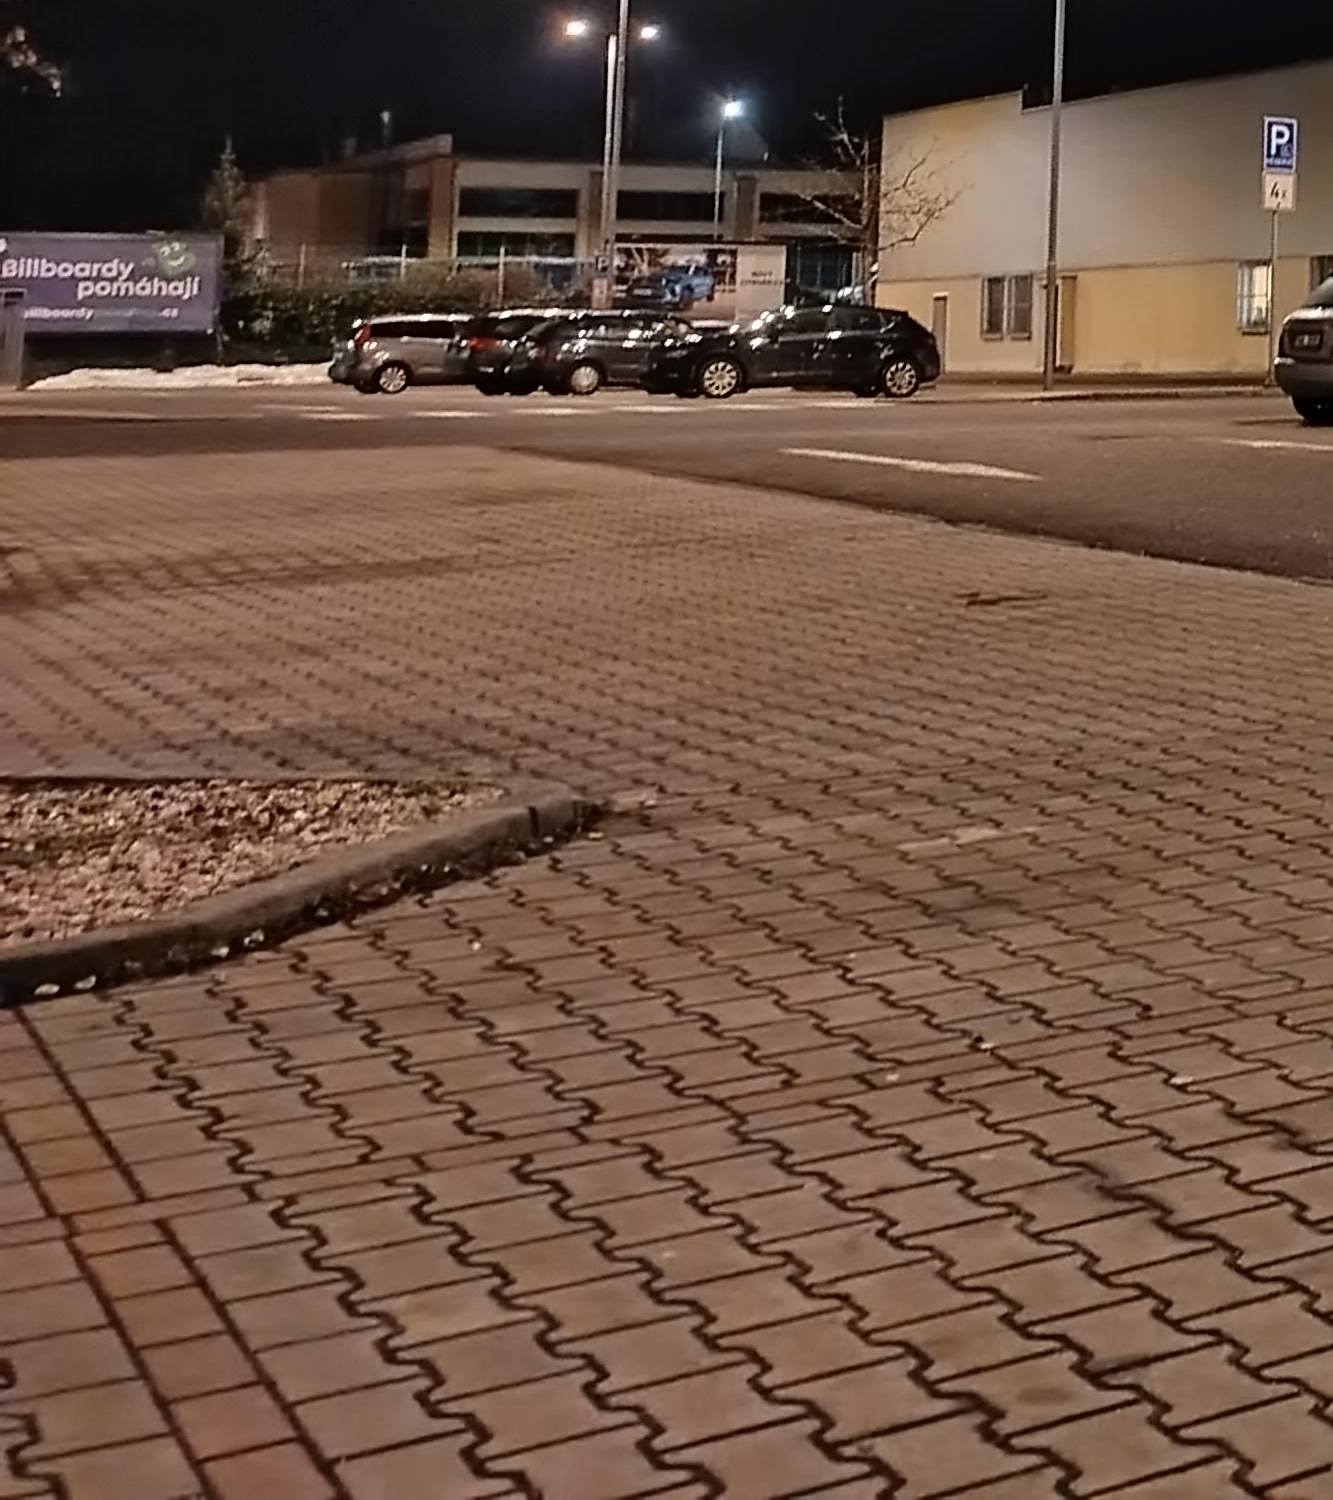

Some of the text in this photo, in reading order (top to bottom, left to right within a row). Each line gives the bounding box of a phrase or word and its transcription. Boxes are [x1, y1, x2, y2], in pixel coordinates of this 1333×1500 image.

[1270, 124, 1290, 156] P
[1, 258, 135, 281] Billboardy
[77, 275, 200, 300] pomáhají
